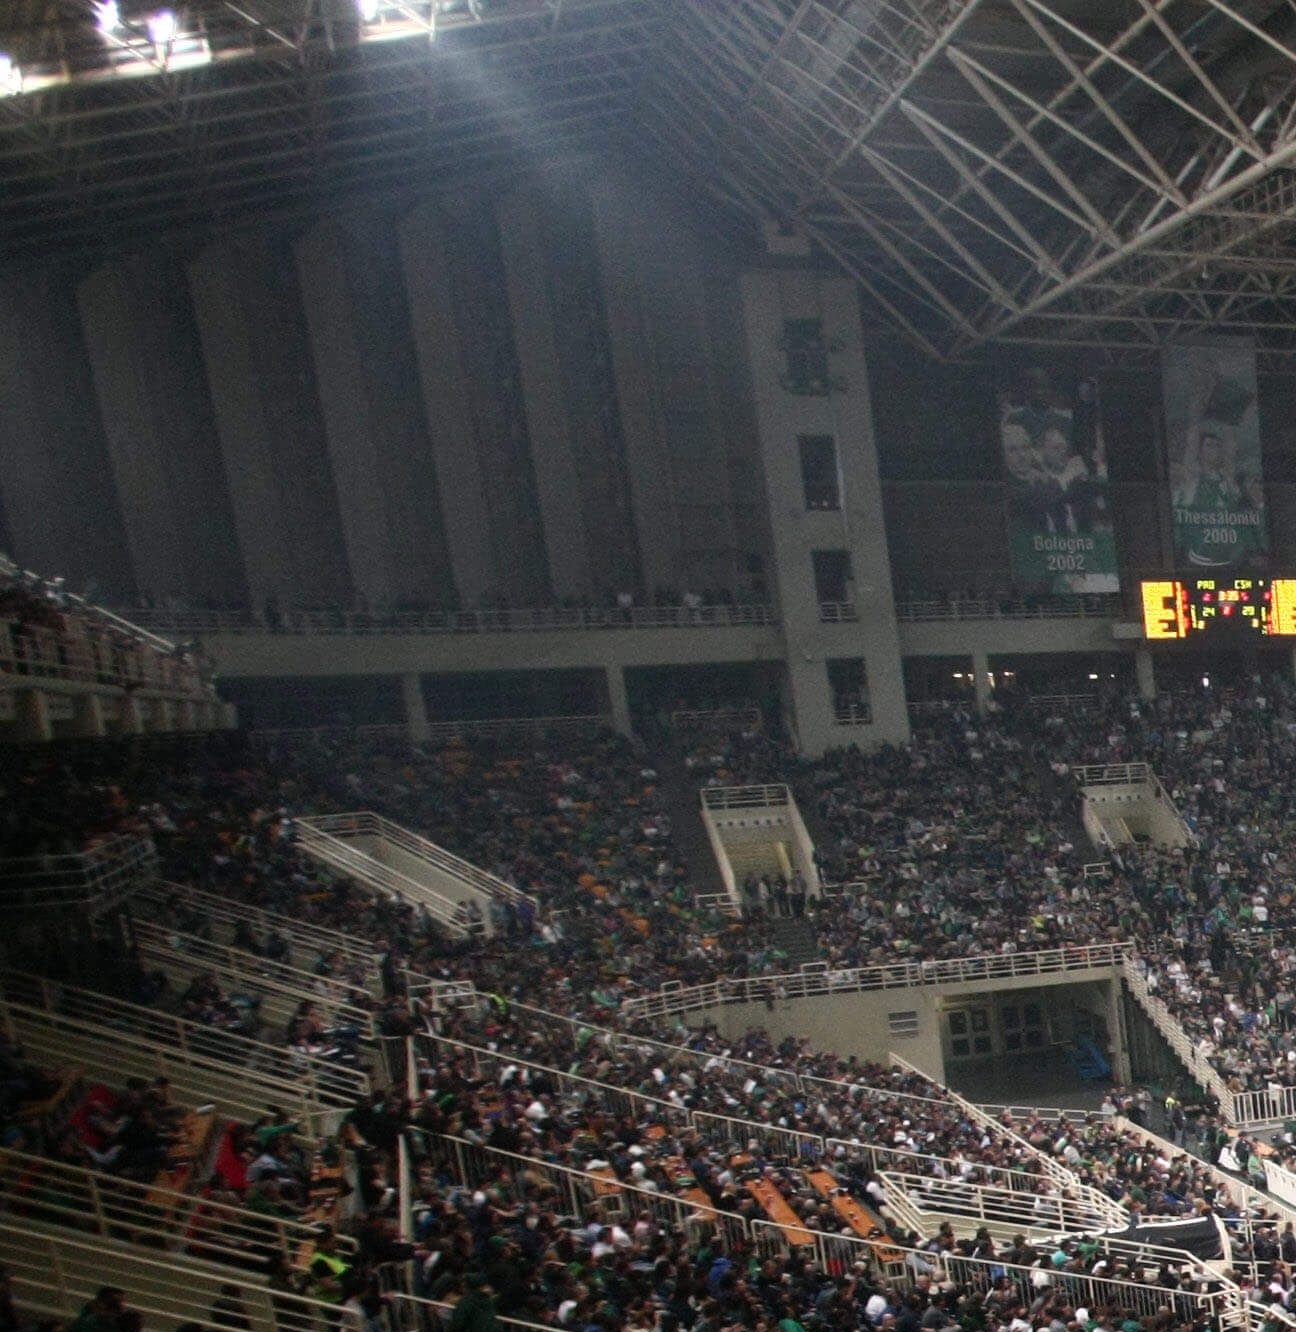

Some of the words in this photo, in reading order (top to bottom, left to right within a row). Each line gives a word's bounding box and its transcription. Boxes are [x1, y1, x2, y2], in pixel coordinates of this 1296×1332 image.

[1177, 510, 1260, 526] Thessaloniki
[1203, 529, 1237, 544] 2000
[1034, 536, 1094, 553] Bologna
[1047, 555, 1085, 570] 2002
